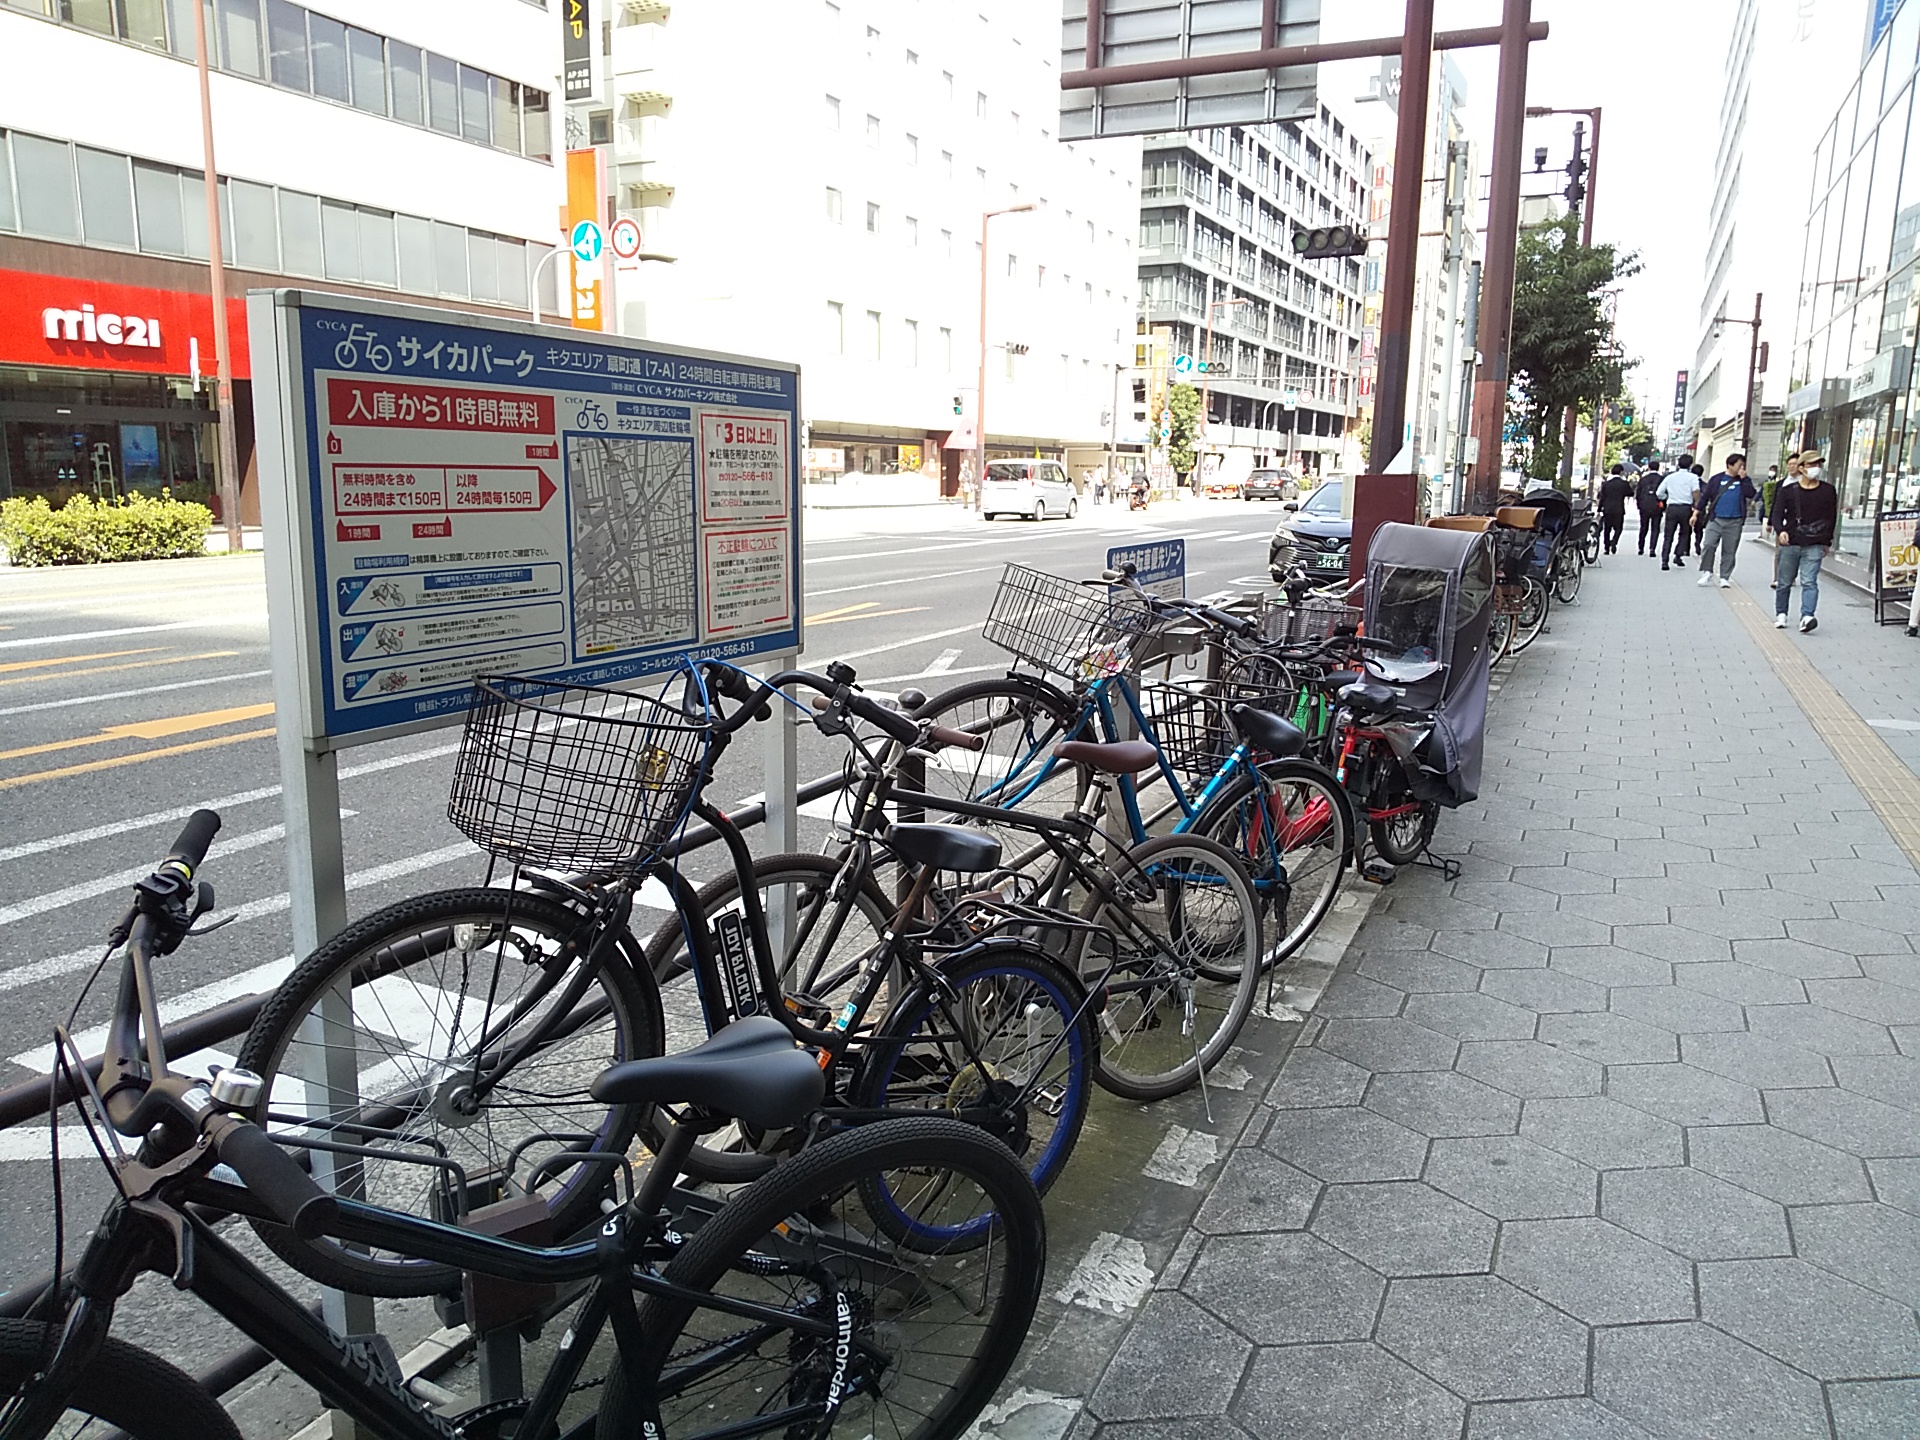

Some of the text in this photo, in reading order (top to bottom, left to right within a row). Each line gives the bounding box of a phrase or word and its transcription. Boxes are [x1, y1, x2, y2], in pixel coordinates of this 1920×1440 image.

[42, 303, 161, 348] mic21
[316, 319, 347, 332] CYCA
[396, 335, 535, 378] サイカパーク
[546, 347, 603, 368] キタエリア
[606, 354, 642, 377] 扇町通
[565, 396, 584, 405] CYCA
[637, 383, 663, 396] CYCA
[664, 387, 738, 404] サイカパーキング株式会社
[346, 389, 540, 429] 入庫から1時間無料
[617, 418, 691, 435] キタエリア周辺駐輪場
[330, 439, 339, 453] 0
[531, 447, 551, 457] 1時間
[342, 473, 416, 487] 無料時間を含め
[456, 474, 479, 488] 以降
[343, 491, 442, 507] 24時間まで150円
[456, 491, 533, 506] 24時間毎150円
[347, 528, 371, 539] 1時間
[417, 526, 445, 536] 24時間
[717, 537, 778, 553] 不正駐輪について
[1322, 559, 1343, 568] 56-04
[700, 640, 755, 659] 0120-566-613
[731, 953, 754, 1007] BLOCK
